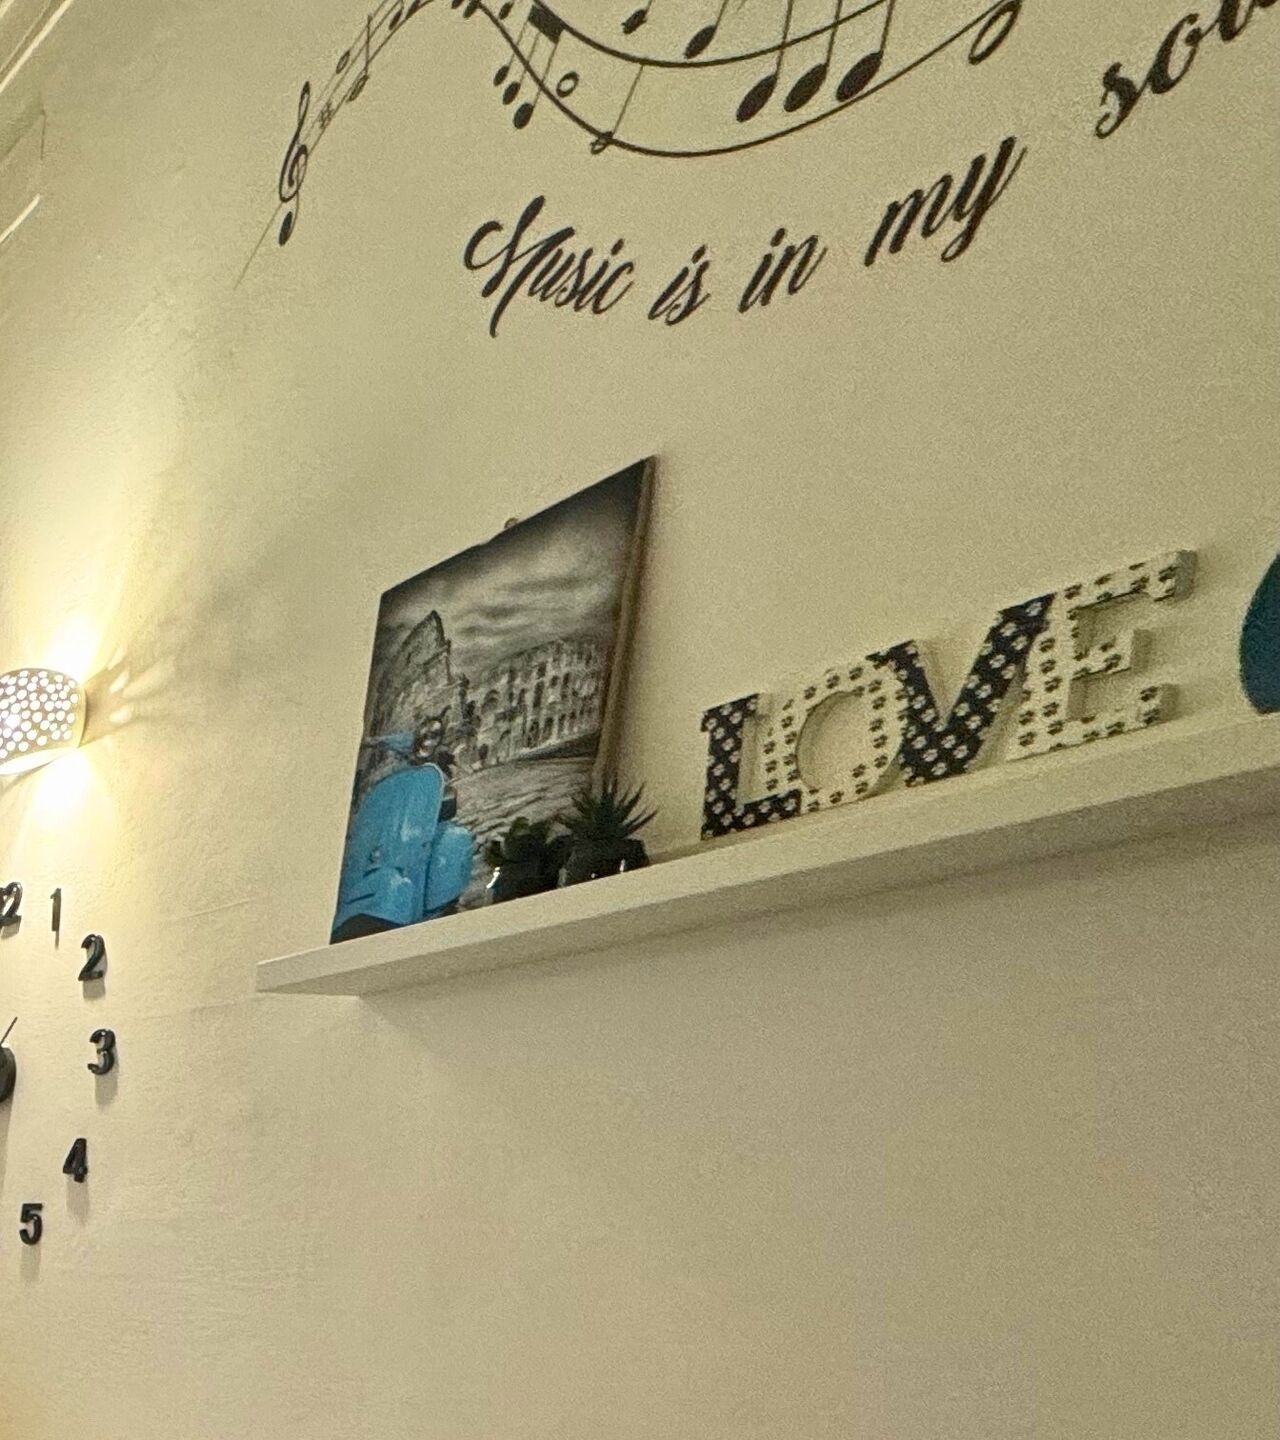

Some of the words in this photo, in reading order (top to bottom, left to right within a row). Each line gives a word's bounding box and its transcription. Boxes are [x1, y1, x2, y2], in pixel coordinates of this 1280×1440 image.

[462, 195, 635, 339] Music
[647, 243, 711, 327] is
[738, 227, 829, 315] in
[863, 135, 1028, 268] my
[1094, 0, 1278, 139] so
[700, 548, 1198, 841] LOVE
[50, 887, 62, 932] 1
[77, 933, 107, 982] 2
[87, 1028, 117, 1076] 3
[62, 1137, 89, 1183] 4
[19, 1203, 44, 1245] 5
